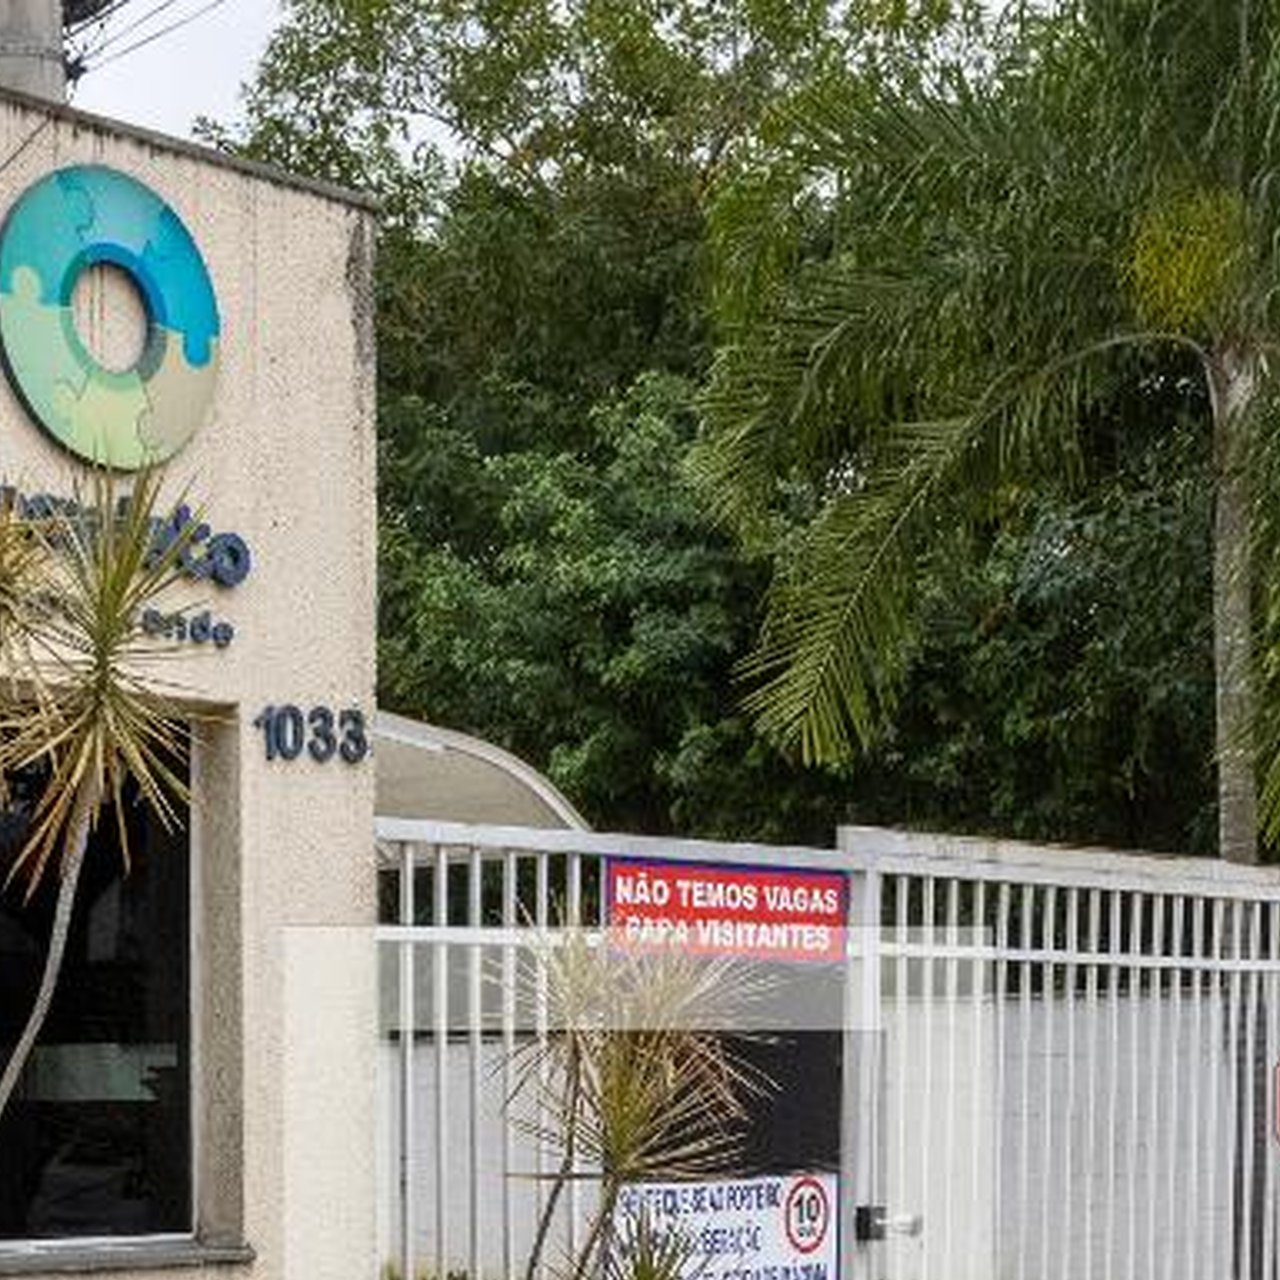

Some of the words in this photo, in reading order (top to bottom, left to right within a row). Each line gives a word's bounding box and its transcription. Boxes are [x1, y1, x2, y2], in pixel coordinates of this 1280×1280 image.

[253, 704, 368, 763] 1033
[615, 872, 669, 905] NÃO
[677, 880, 758, 911] TEMOS
[763, 886, 838, 914] VAGAS
[695, 918, 831, 950] VISITANTES
[793, 1193, 820, 1223] 10
